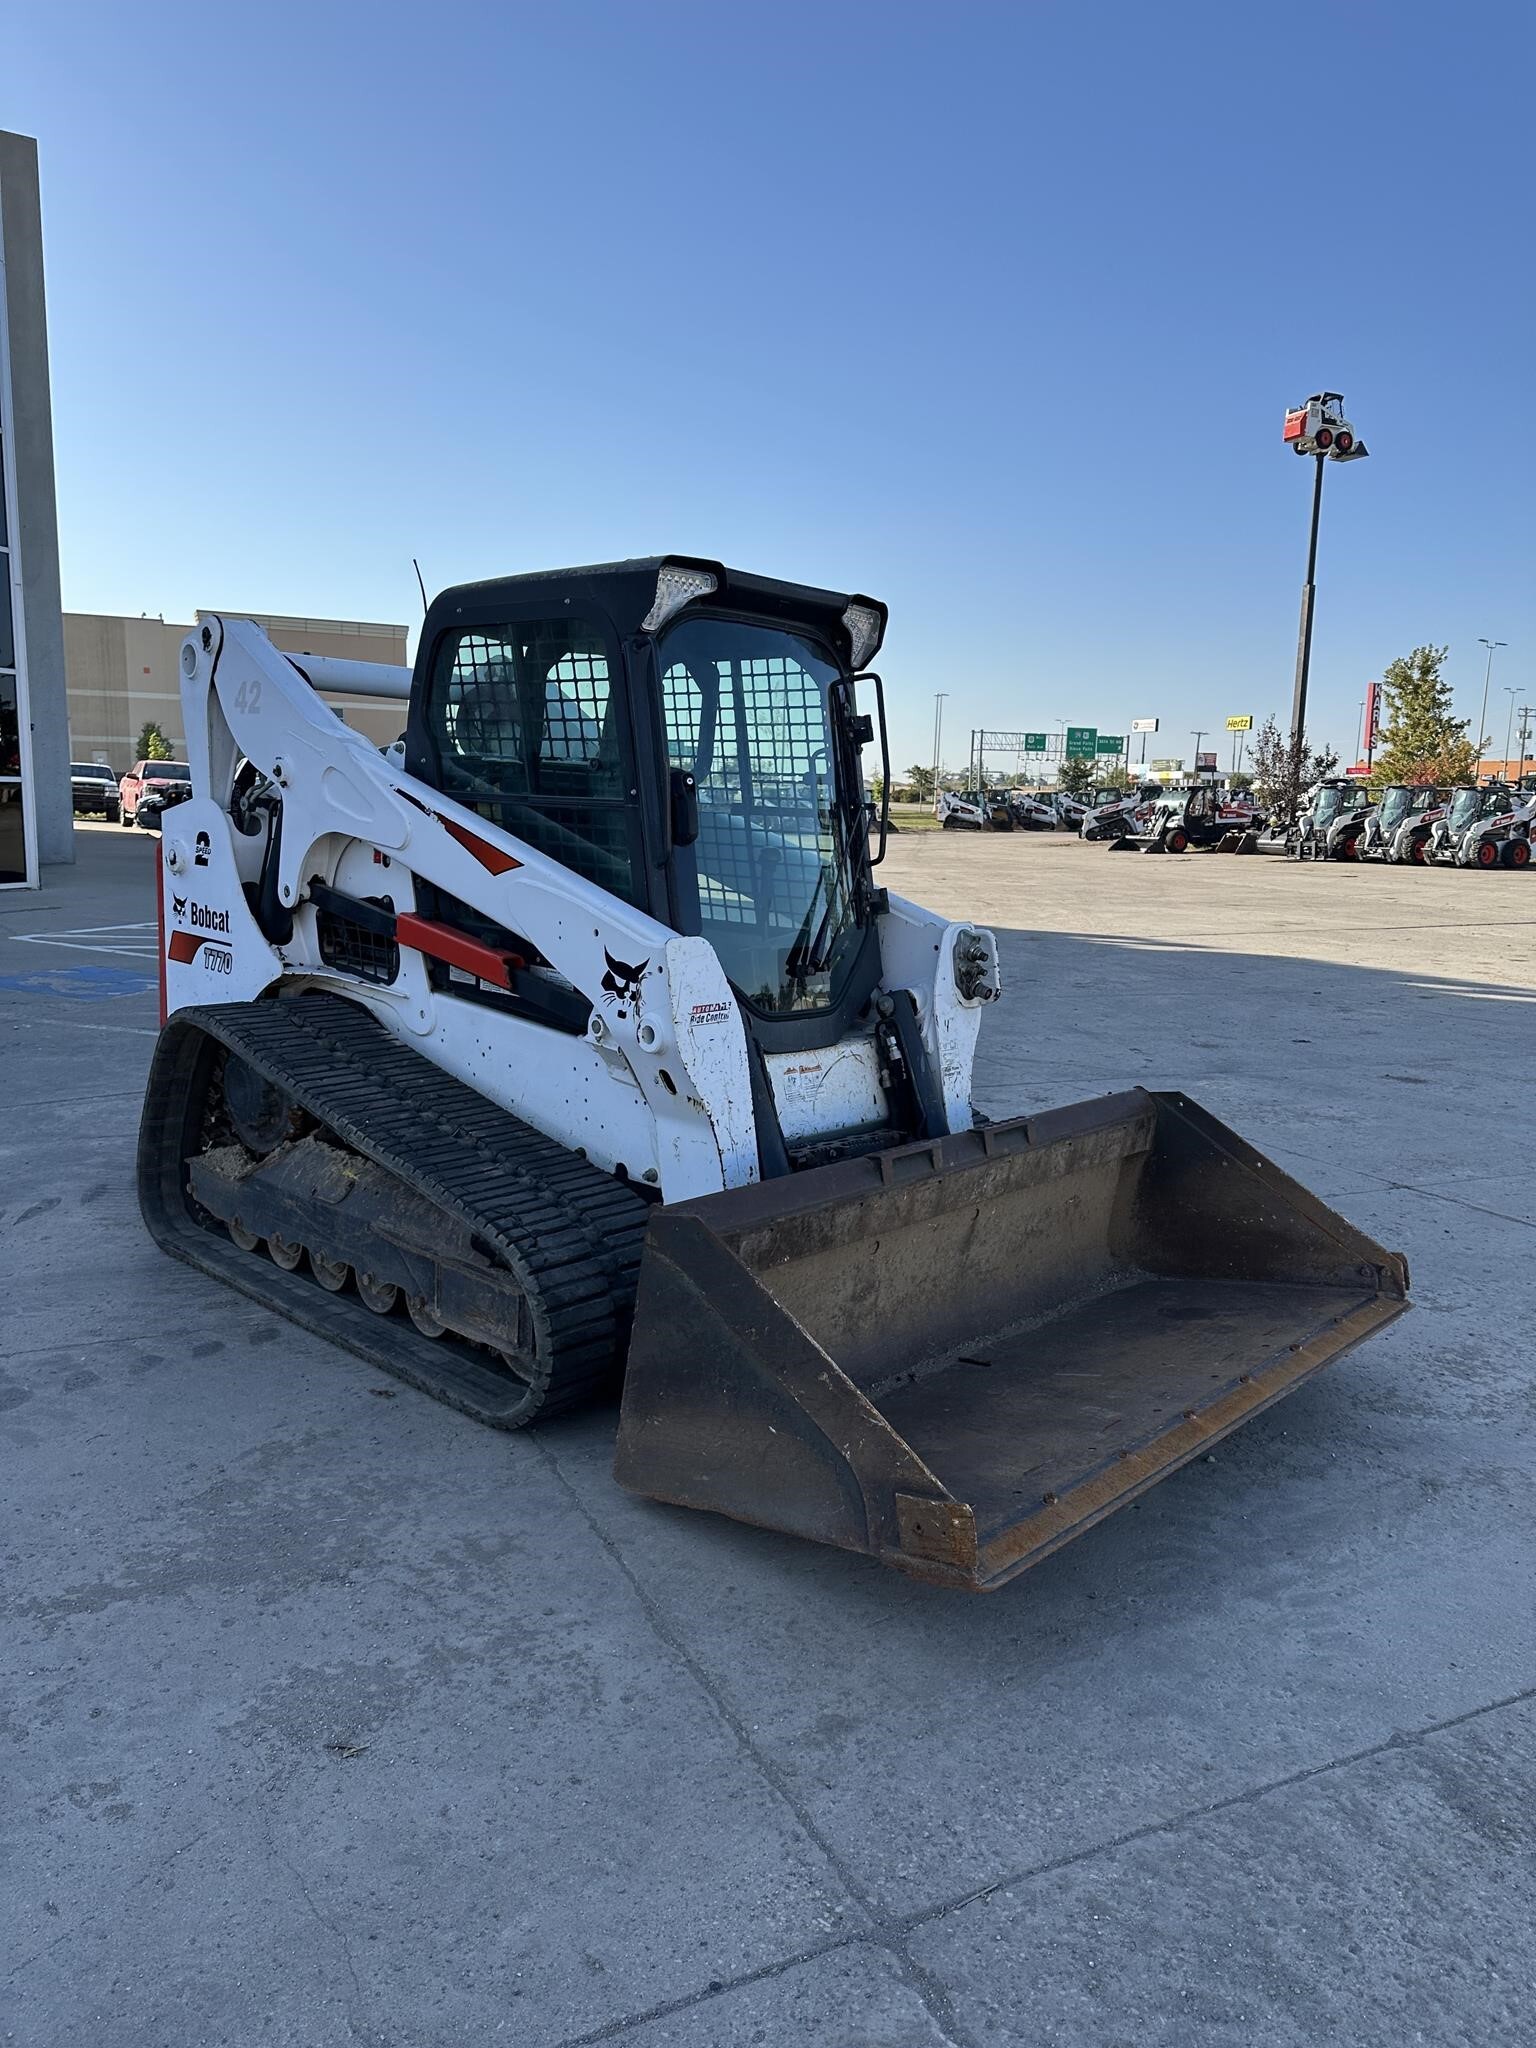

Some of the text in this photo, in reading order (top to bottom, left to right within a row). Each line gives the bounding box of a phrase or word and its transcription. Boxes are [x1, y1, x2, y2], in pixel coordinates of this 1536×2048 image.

[235, 681, 261, 714] 42
[1227, 719, 1249, 728] Hertz
[196, 846, 211, 855] SPEED
[191, 902, 229, 933] Bobcat
[204, 947, 232, 974] T770
